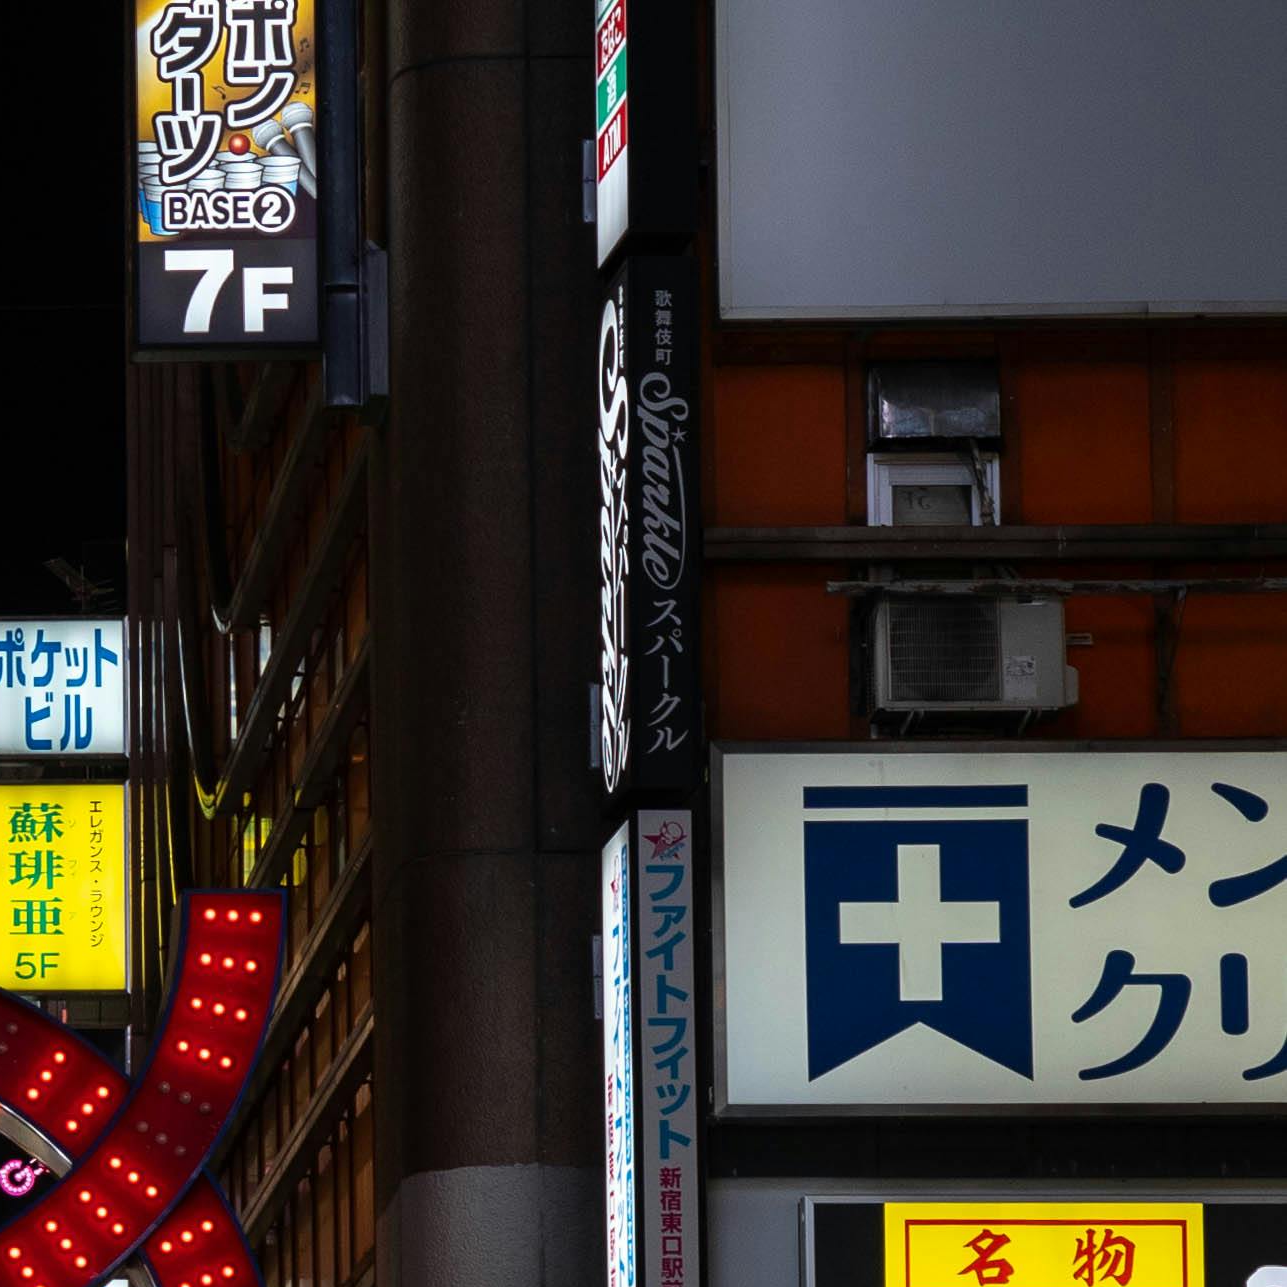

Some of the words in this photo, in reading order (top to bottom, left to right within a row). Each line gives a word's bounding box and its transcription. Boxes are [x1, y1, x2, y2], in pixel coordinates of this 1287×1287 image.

[151, 0, 223, 184] ダーツ
[602, 114, 622, 171] ATM
[164, 249, 294, 332] 7F
[655, 290, 673, 366] 歌舞伎町
[636, 371, 689, 590] Sparkle
[25, 692, 94, 752] ビル
[644, 600, 689, 754] スパークル
[89, 800, 105, 949] エレガンス・ラウンジ
[1069, 781, 1287, 910] メン
[14, 952, 60, 981] 5F
[645, 863, 694, 1160] ファイトフィット
[957, 1228, 1137, 1287] 名物
